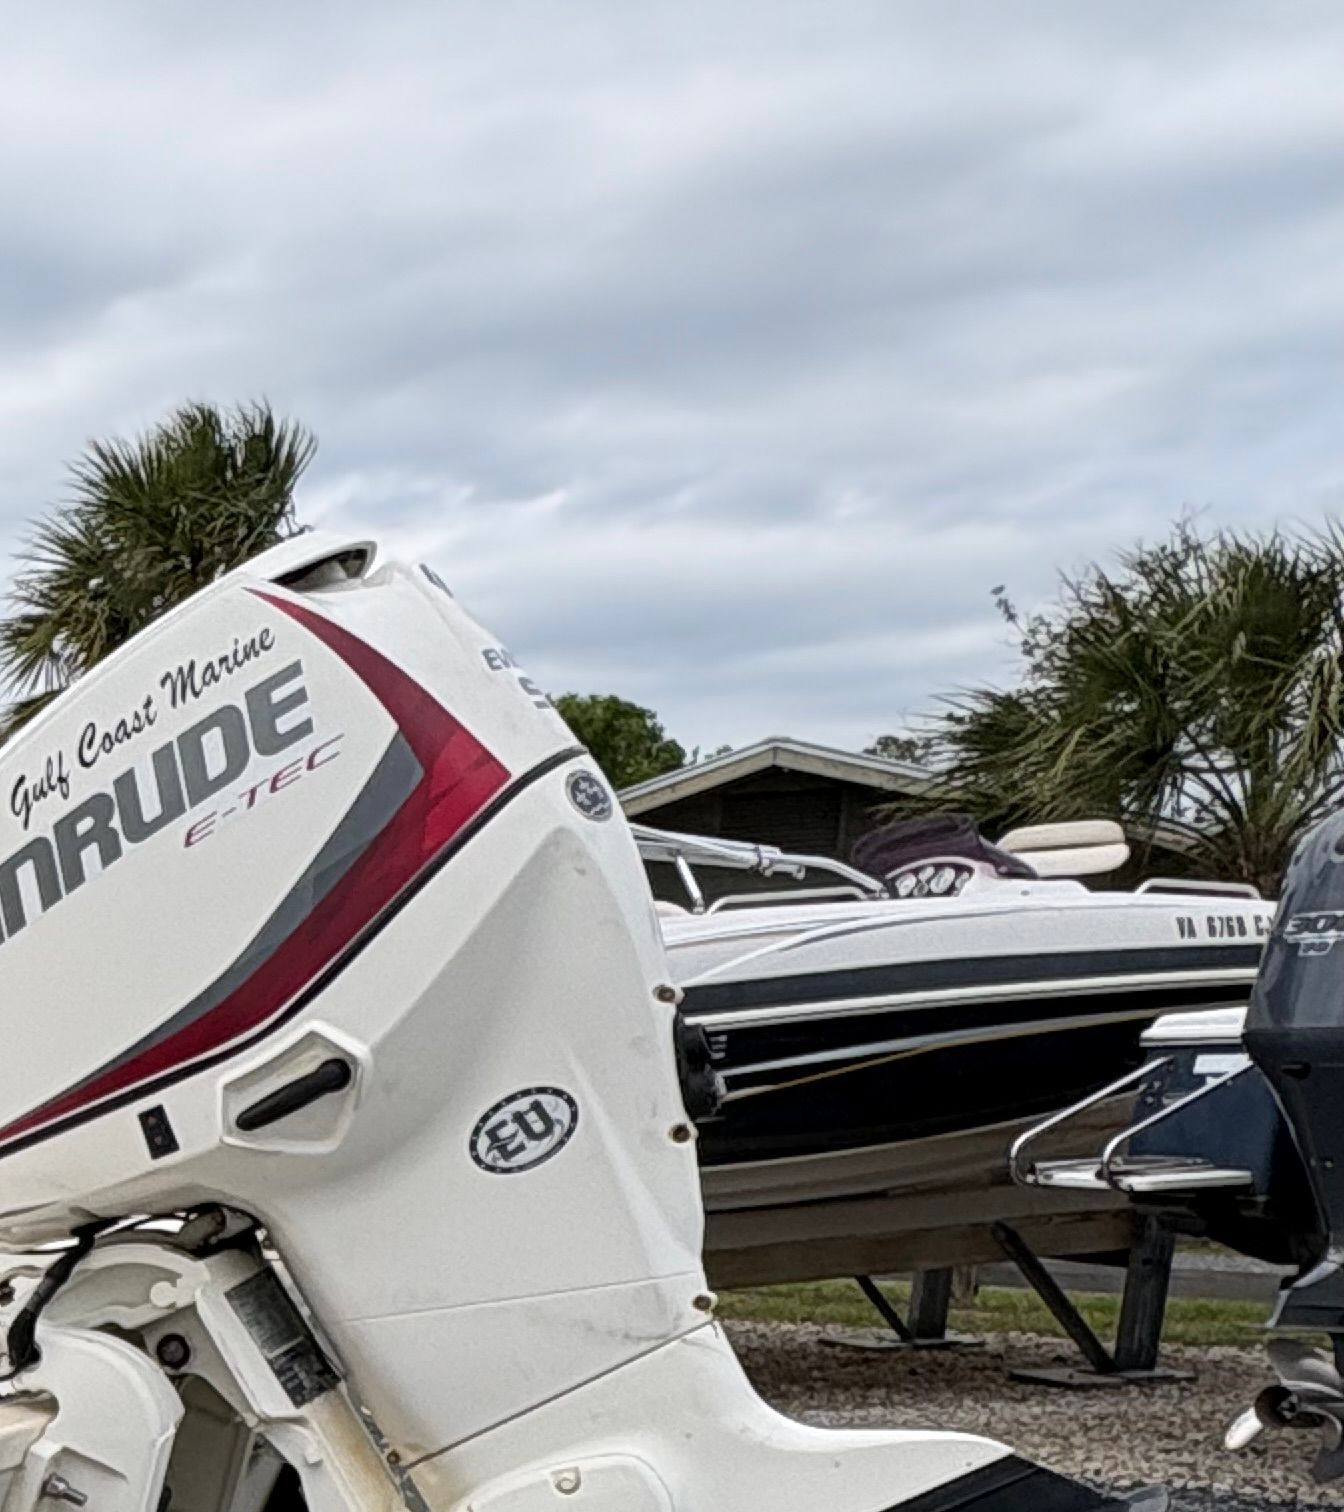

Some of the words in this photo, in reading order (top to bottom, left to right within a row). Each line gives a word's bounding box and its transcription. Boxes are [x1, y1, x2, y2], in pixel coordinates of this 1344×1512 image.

[9, 750, 72, 832] Gulf
[77, 694, 159, 769] Coast
[162, 627, 276, 709] Marine
[183, 732, 346, 849] E-TEC
